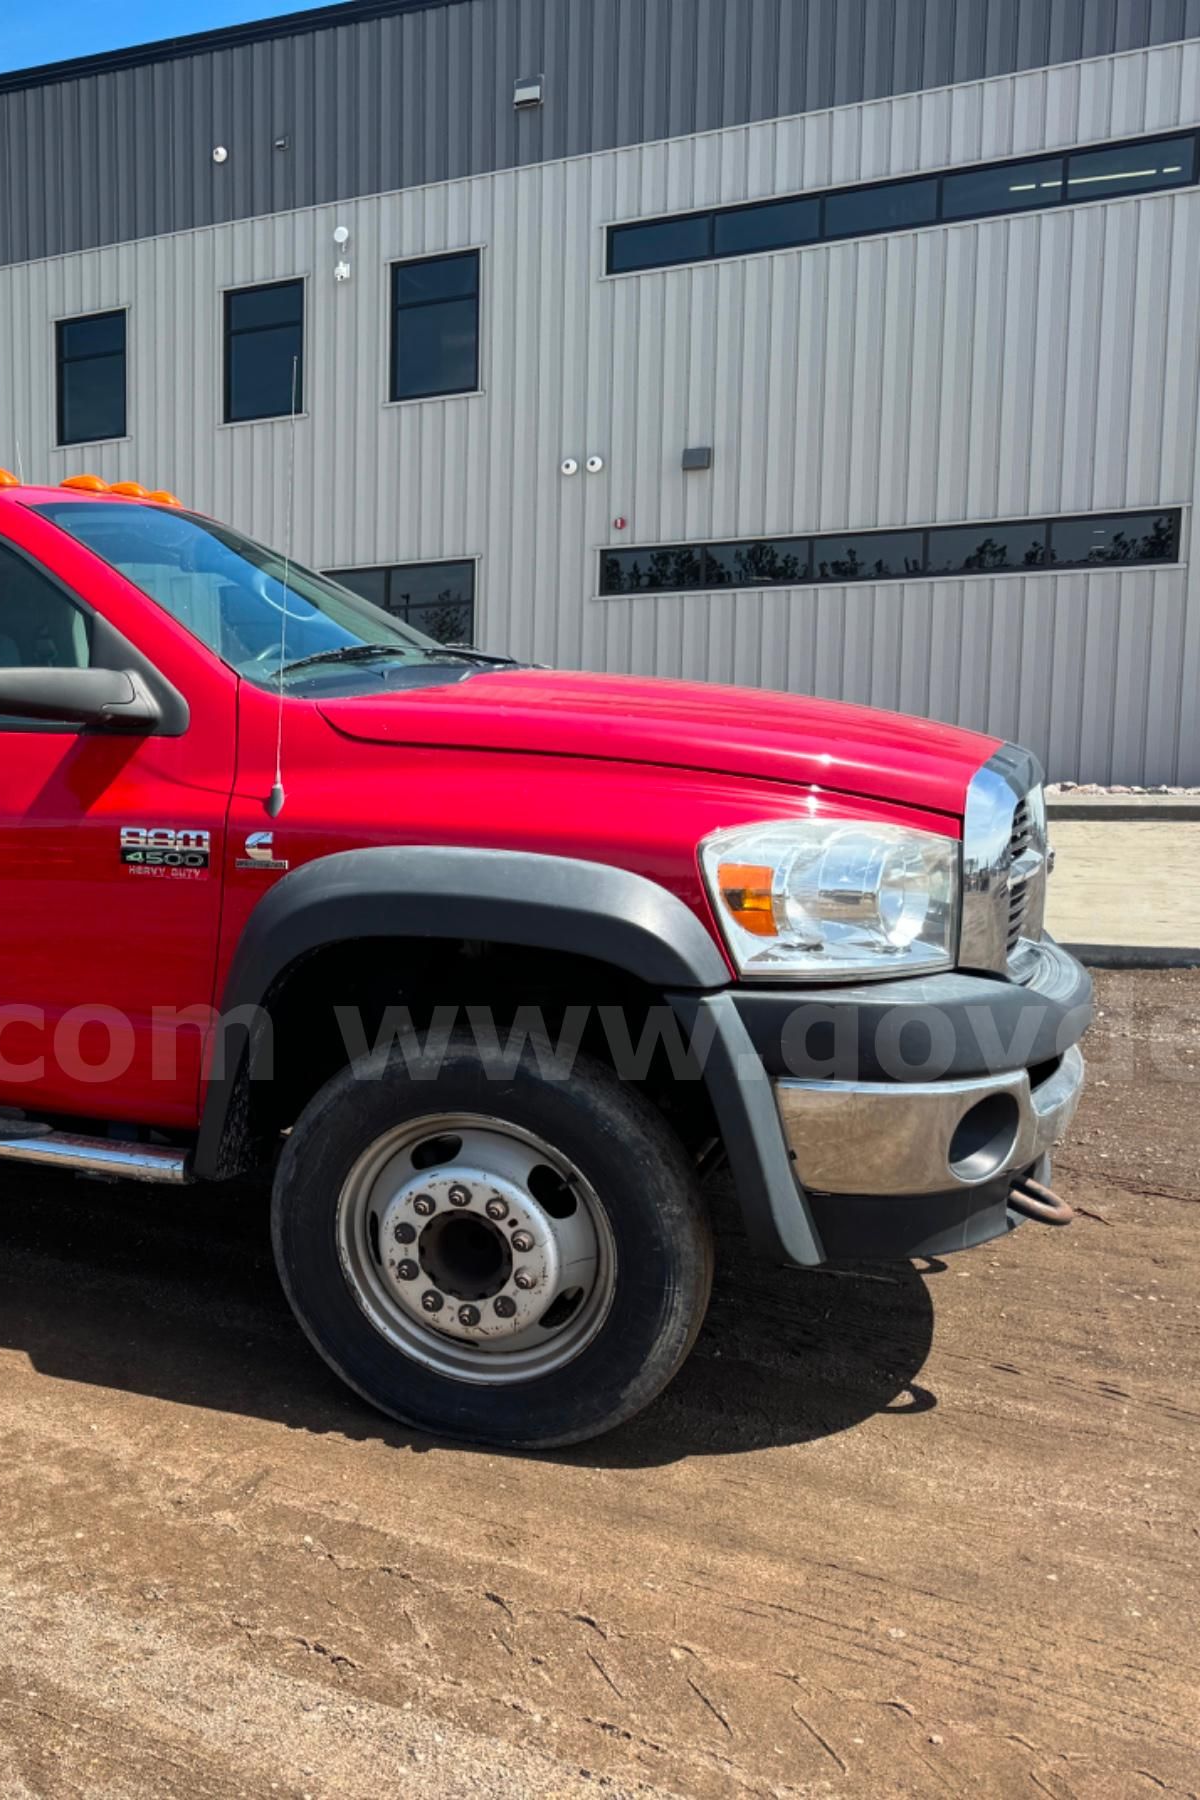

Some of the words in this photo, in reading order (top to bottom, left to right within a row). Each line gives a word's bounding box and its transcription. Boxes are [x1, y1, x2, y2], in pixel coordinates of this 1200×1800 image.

[121, 828, 210, 852] RAM
[126, 851, 204, 867] 4500
[128, 865, 166, 876] HEAVY
[170, 867, 202, 880] DUTY
